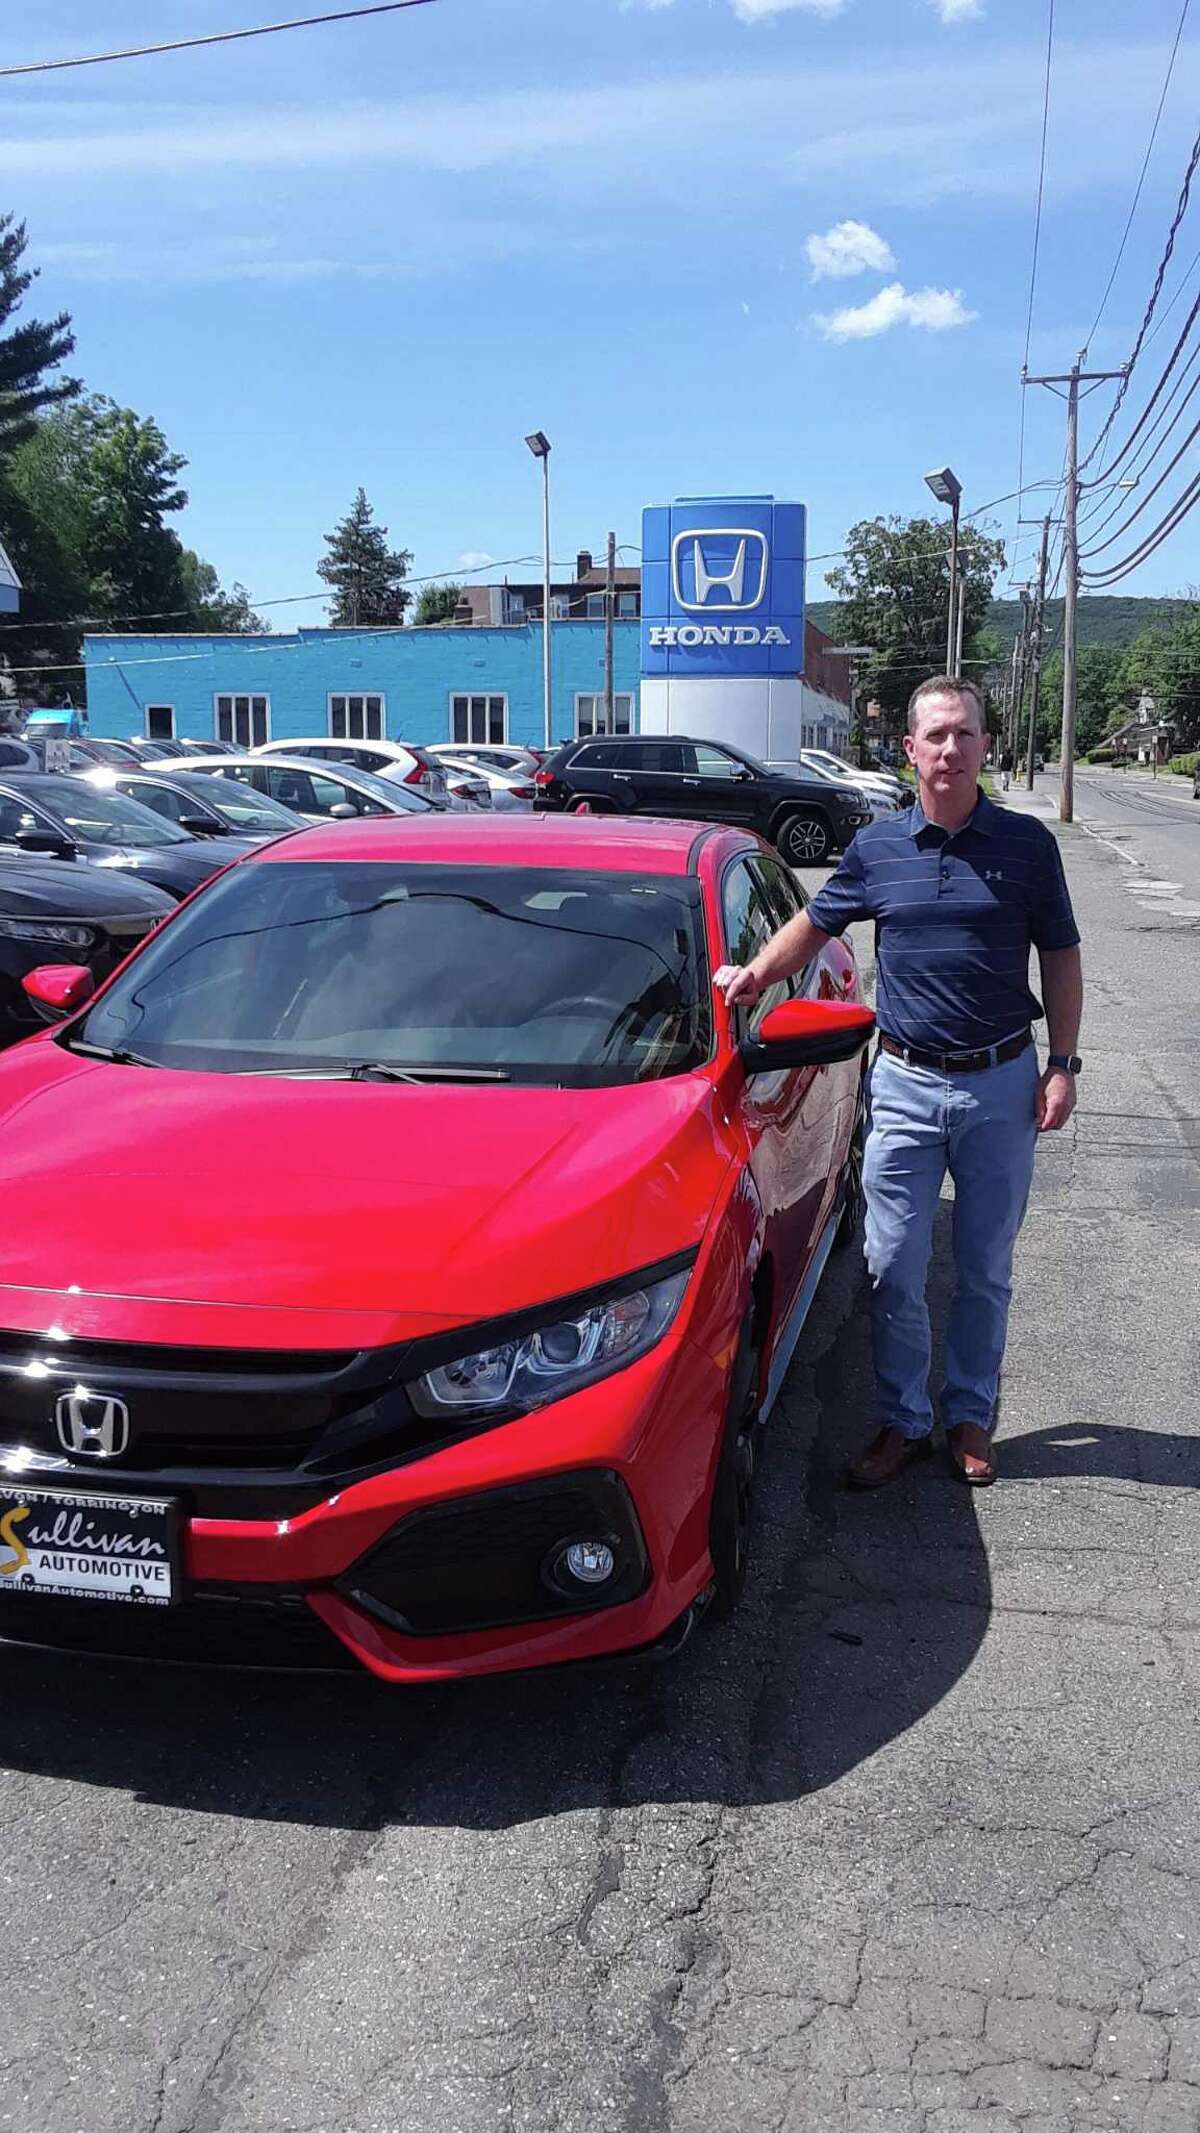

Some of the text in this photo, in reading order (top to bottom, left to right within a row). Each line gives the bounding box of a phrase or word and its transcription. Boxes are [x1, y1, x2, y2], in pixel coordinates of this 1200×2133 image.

[649, 626, 791, 646] HONDA
[0, 1506, 166, 1575] Sullivan
[39, 1554, 166, 1582] AUTOMOTIVE
